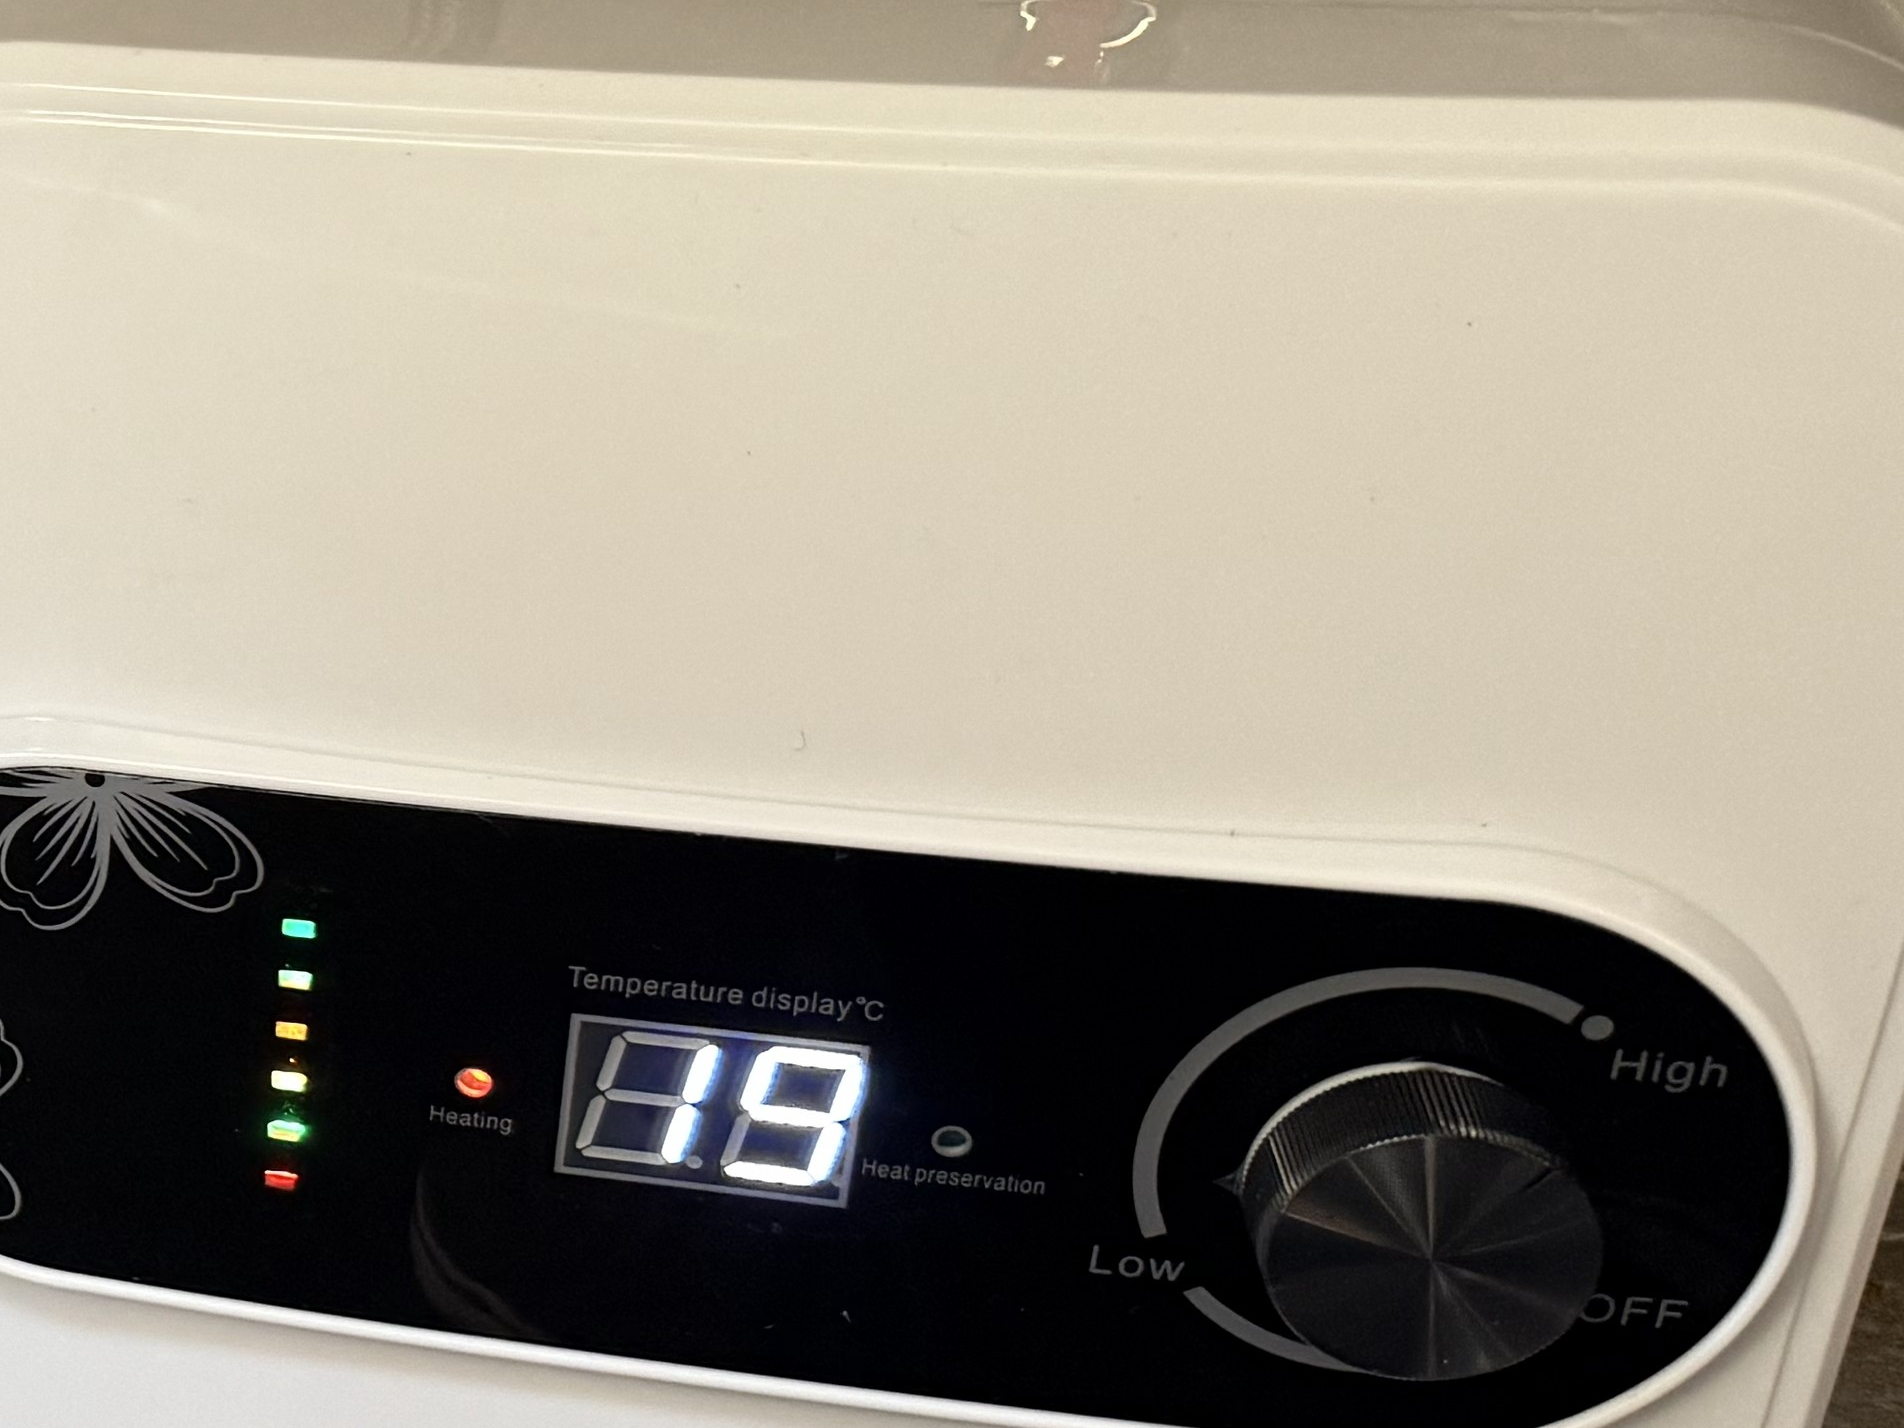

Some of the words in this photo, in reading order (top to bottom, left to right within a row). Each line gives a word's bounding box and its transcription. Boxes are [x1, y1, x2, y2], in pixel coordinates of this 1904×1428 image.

[568, 965, 743, 1005] Temperature
[1609, 1048, 1730, 1094] High
[429, 1104, 513, 1136] Heating
[660, 1043, 867, 1187] 19
[861, 1157, 912, 1182] Heat
[913, 1166, 1047, 1196] preservation
[1088, 1244, 1186, 1282] Low
[1578, 1292, 1690, 1330] OFF
